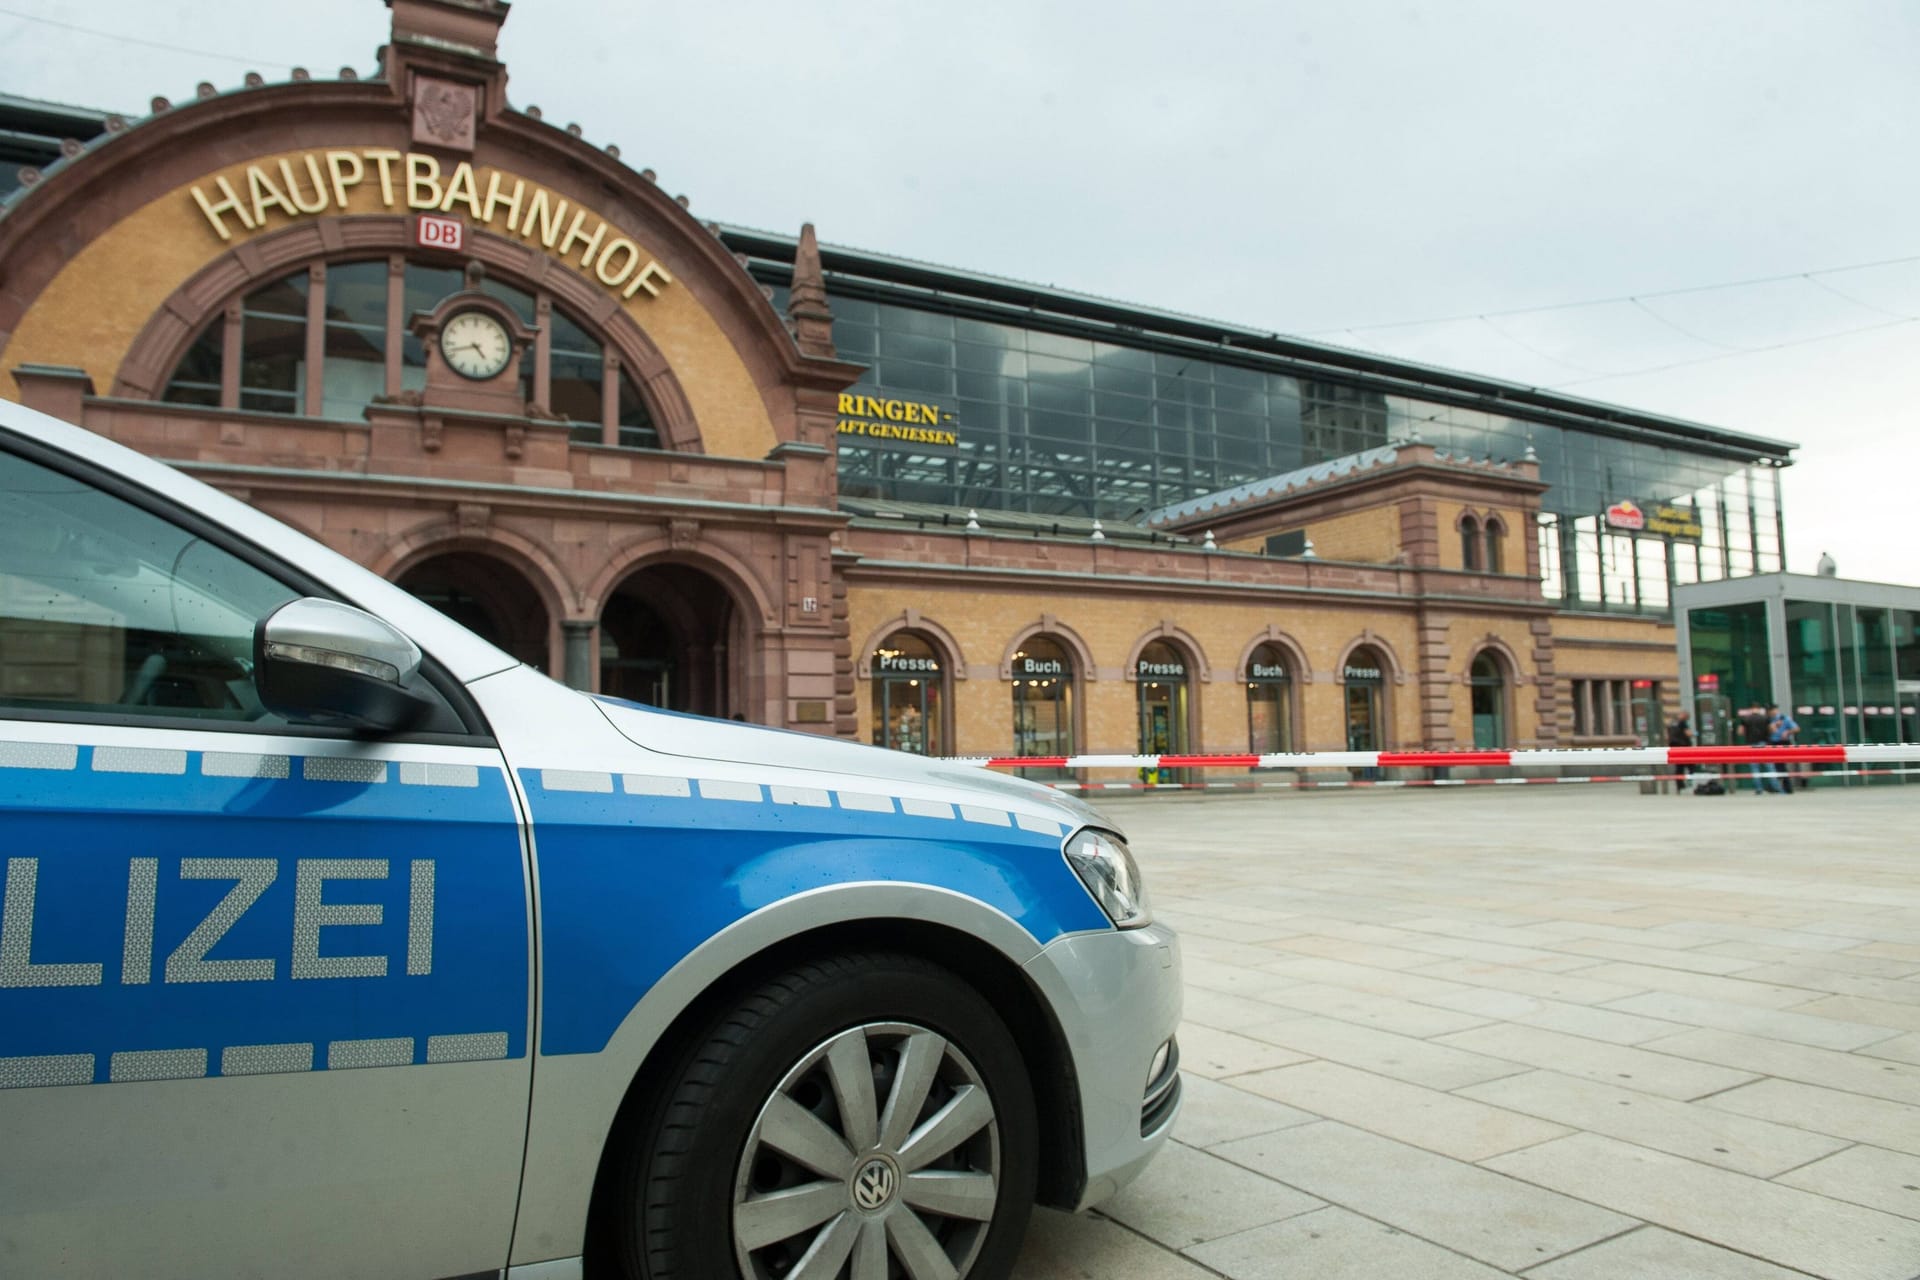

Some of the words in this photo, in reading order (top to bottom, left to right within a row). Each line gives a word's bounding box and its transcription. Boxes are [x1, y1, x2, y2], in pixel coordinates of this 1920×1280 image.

[190, 150, 673, 300] HAUPTBAHNHOF
[425, 222, 456, 244] DB
[869, 423, 955, 444] GENIESSEN
[880, 656, 937, 671] Presse
[1024, 658, 1062, 673] Buch
[1139, 660, 1184, 675] Presse
[1253, 663, 1283, 677] Buch
[1344, 665, 1381, 678] Presse
[0, 857, 436, 988] LIZEI
[854, 1159, 894, 1210] VW
